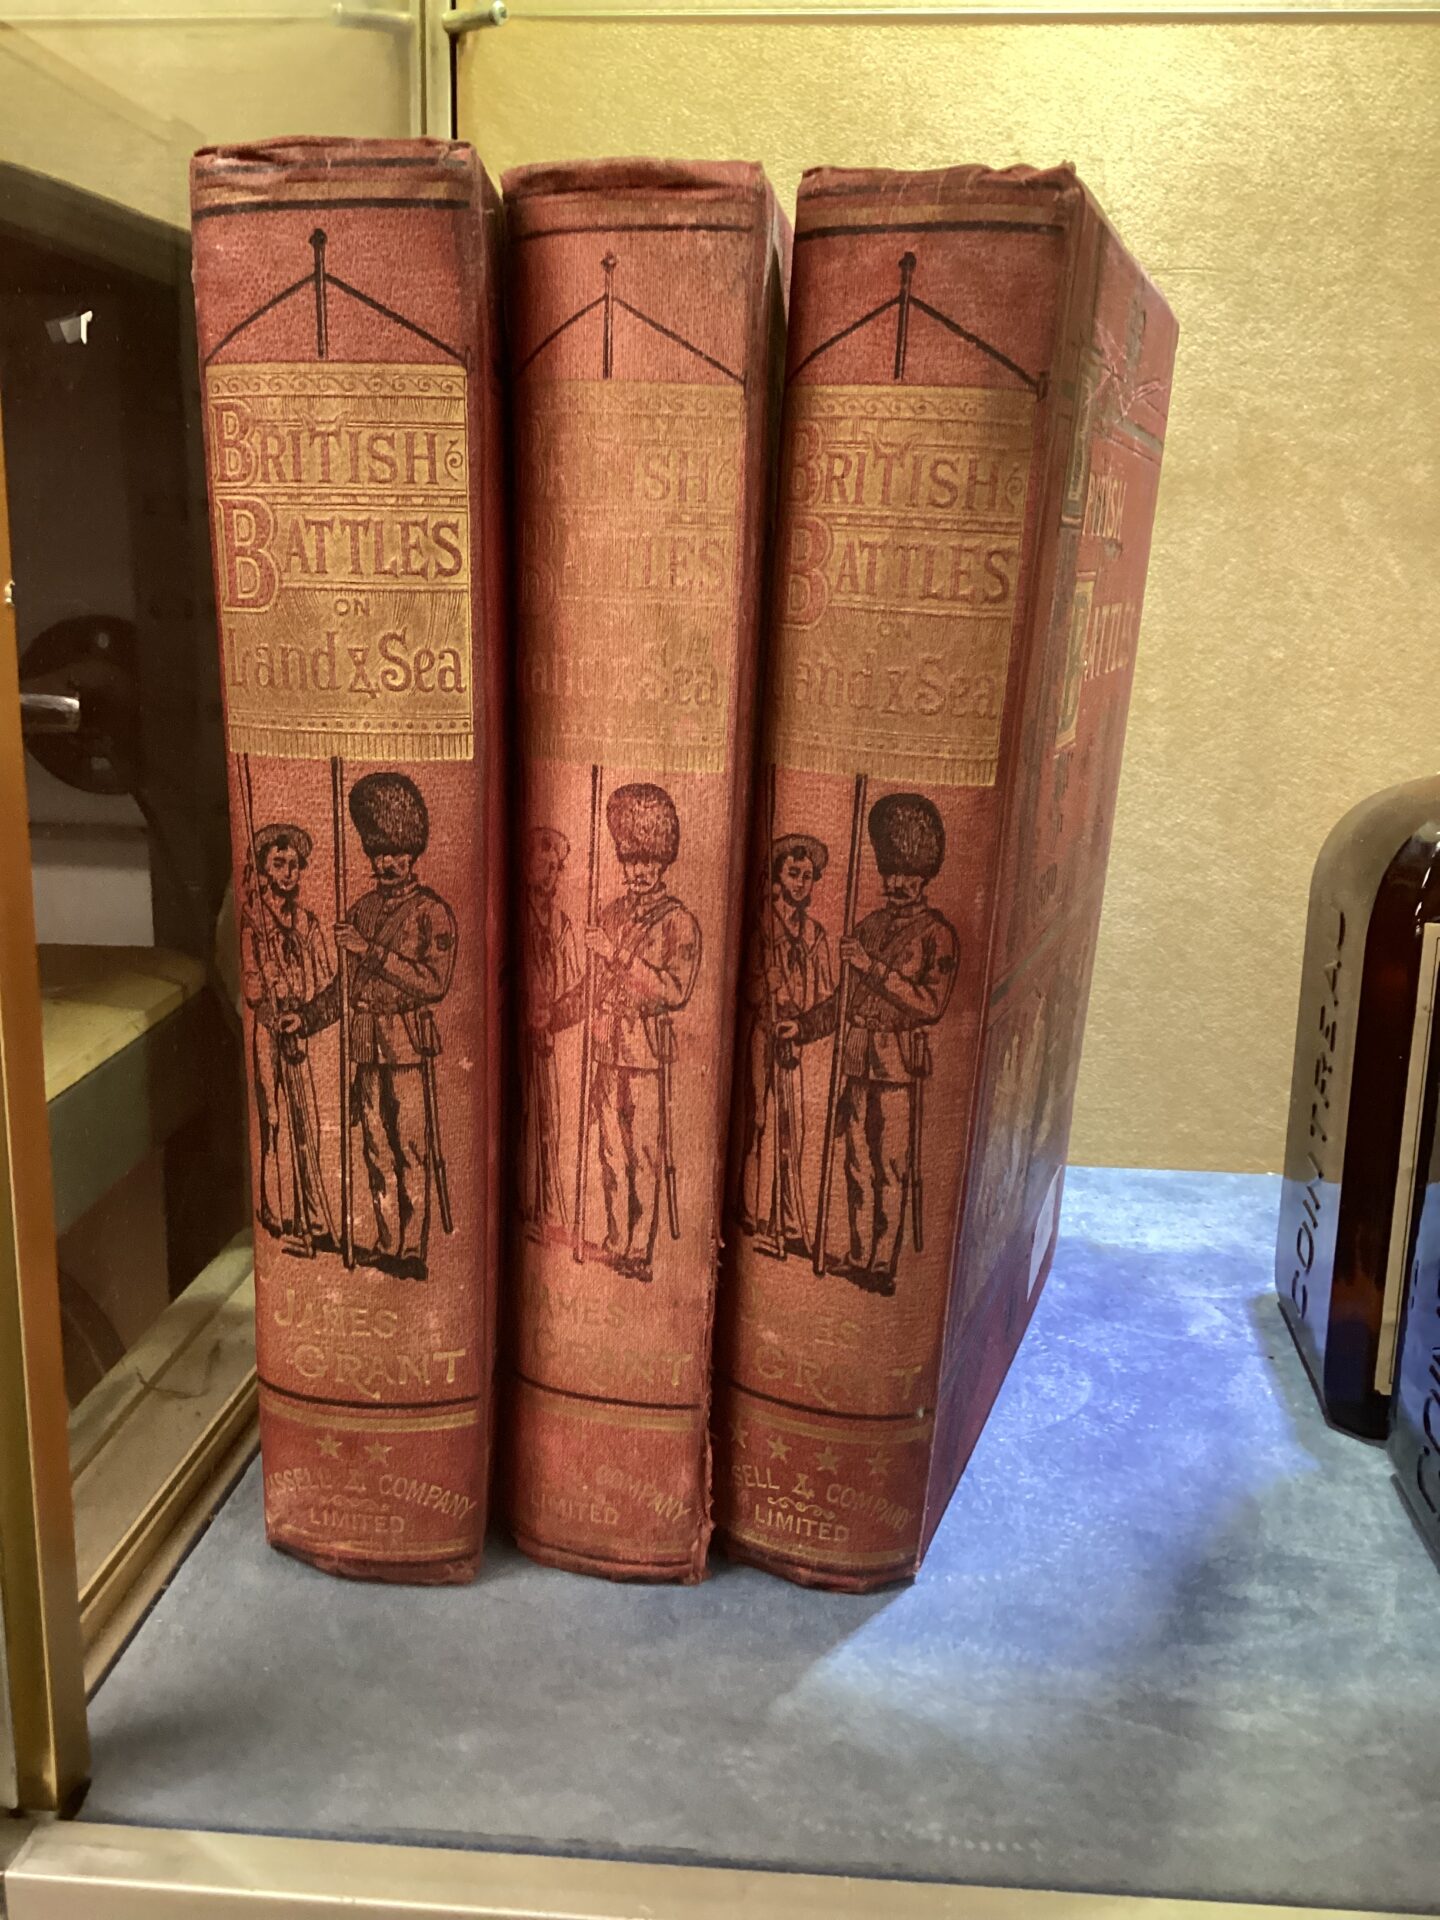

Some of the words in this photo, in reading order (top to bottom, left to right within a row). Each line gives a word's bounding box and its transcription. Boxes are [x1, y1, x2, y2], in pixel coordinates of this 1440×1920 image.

[210, 398, 440, 487] BRITISH
[788, 421, 1006, 511] BRITISH
[216, 496, 464, 613] BATTLES
[783, 515, 1014, 630] BATTLES
[333, 598, 371, 617] ON
[377, 627, 467, 695] Sea
[292, 1344, 467, 1400] GRANT
[309, 1507, 405, 1534] LIMITED
[379, 1473, 476, 1521] COMPANY
[754, 1503, 850, 1543] LIMITED
